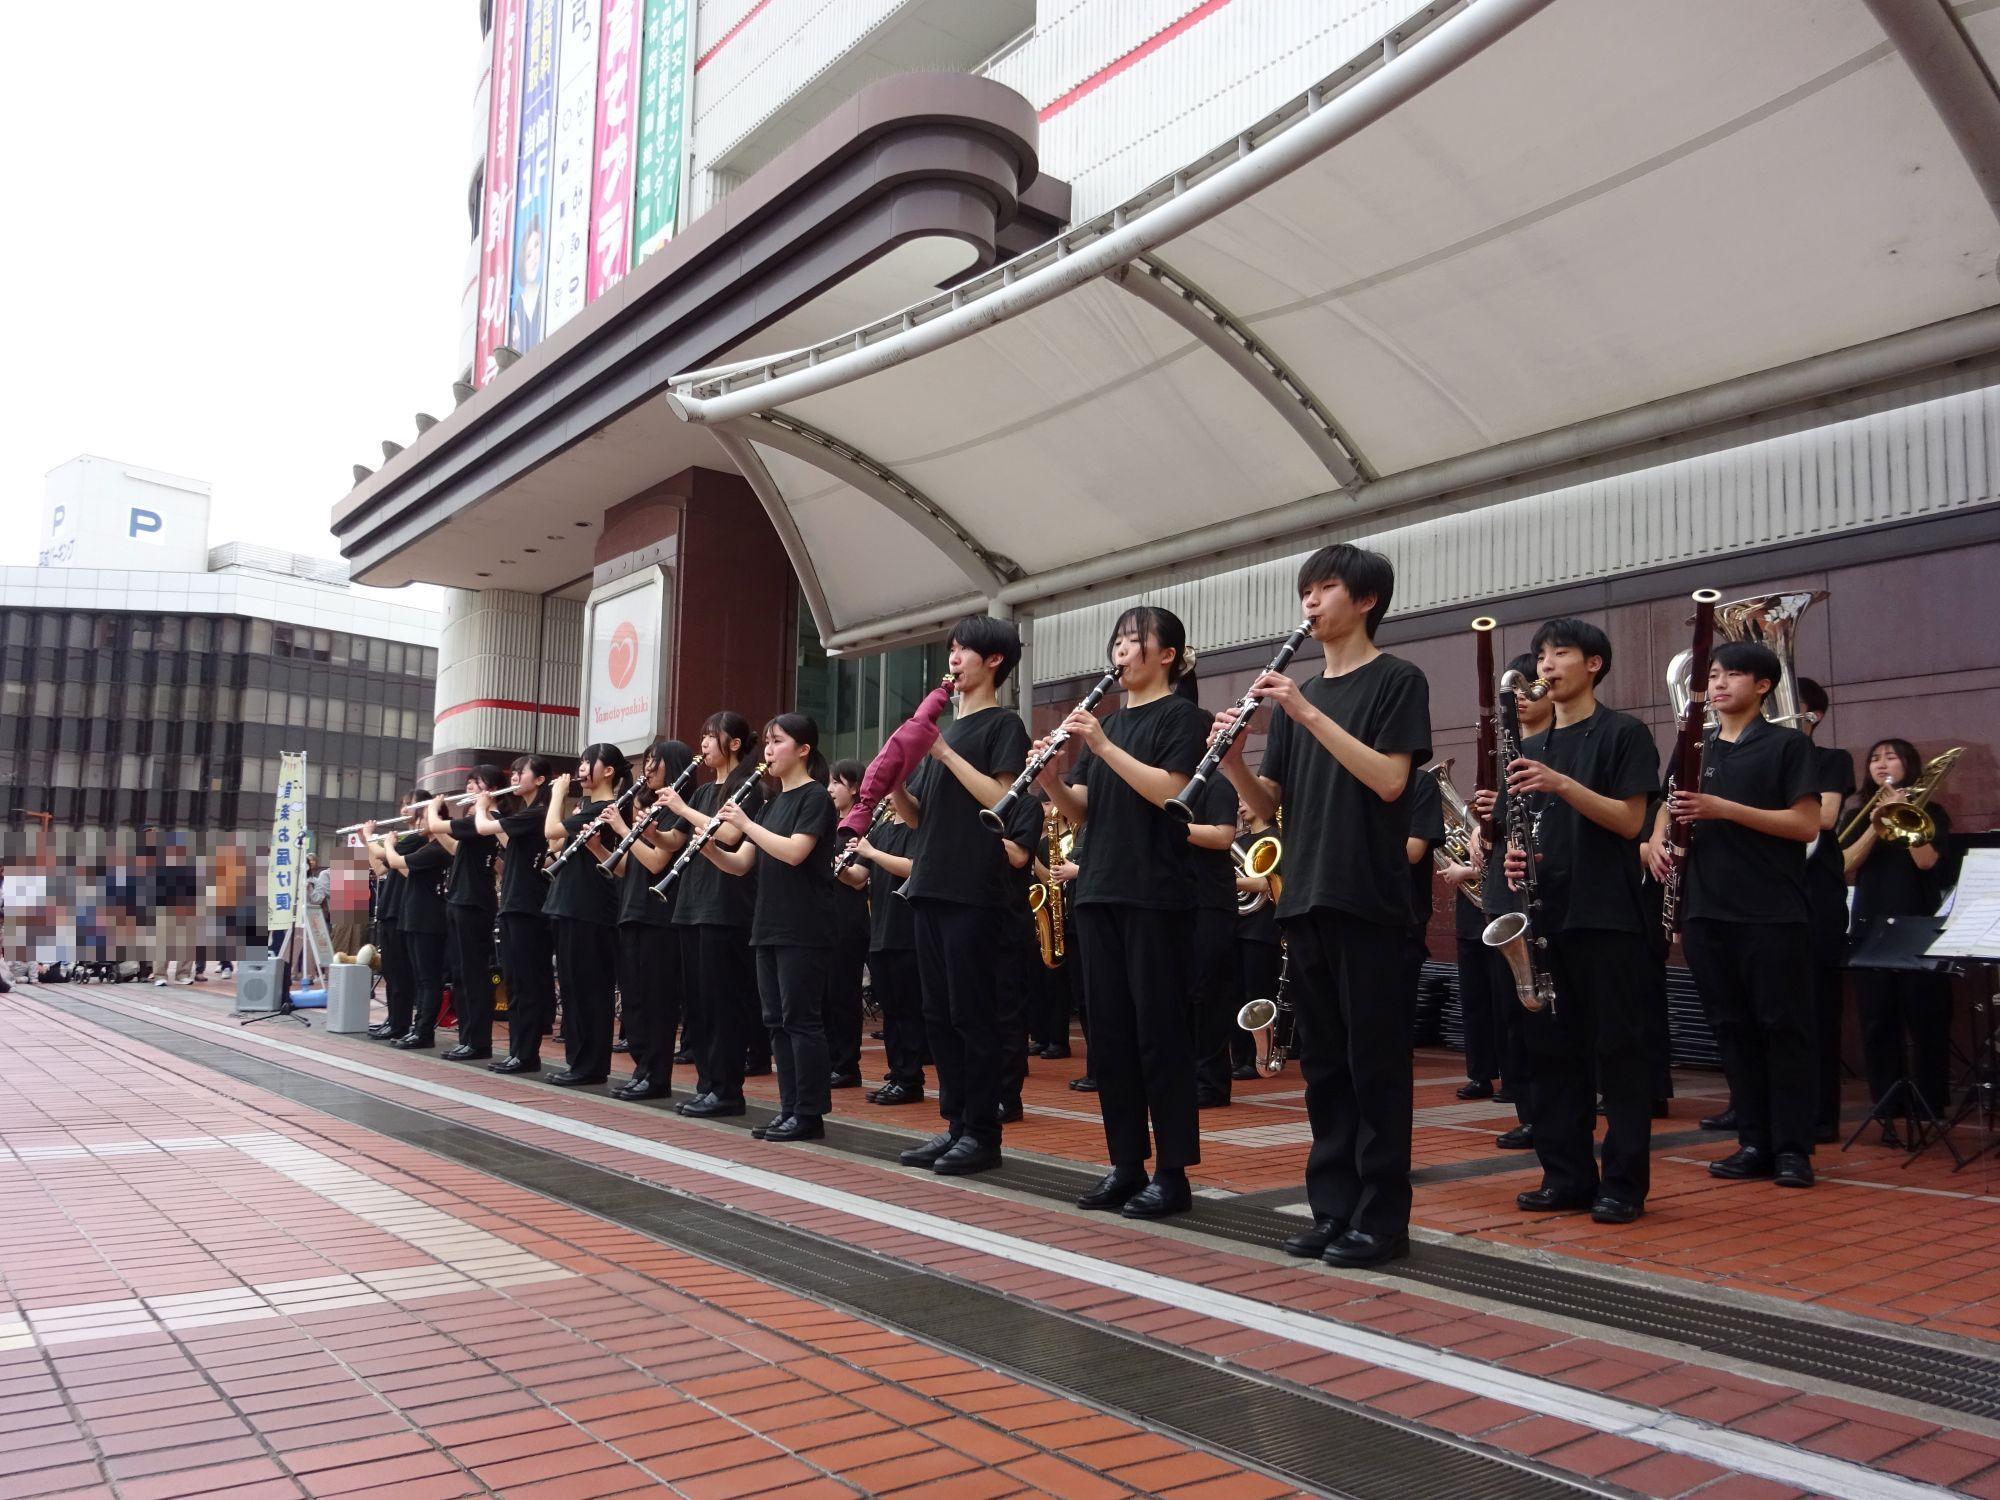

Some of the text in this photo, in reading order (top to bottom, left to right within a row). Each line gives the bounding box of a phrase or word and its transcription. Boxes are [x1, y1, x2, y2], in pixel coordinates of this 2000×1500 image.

[597, 0, 633, 297] 育てプラ
[521, 148, 547, 209] 1F
[52, 505, 66, 537] P
[129, 507, 163, 538] P
[594, 696, 649, 724] Yamatoyashiki
